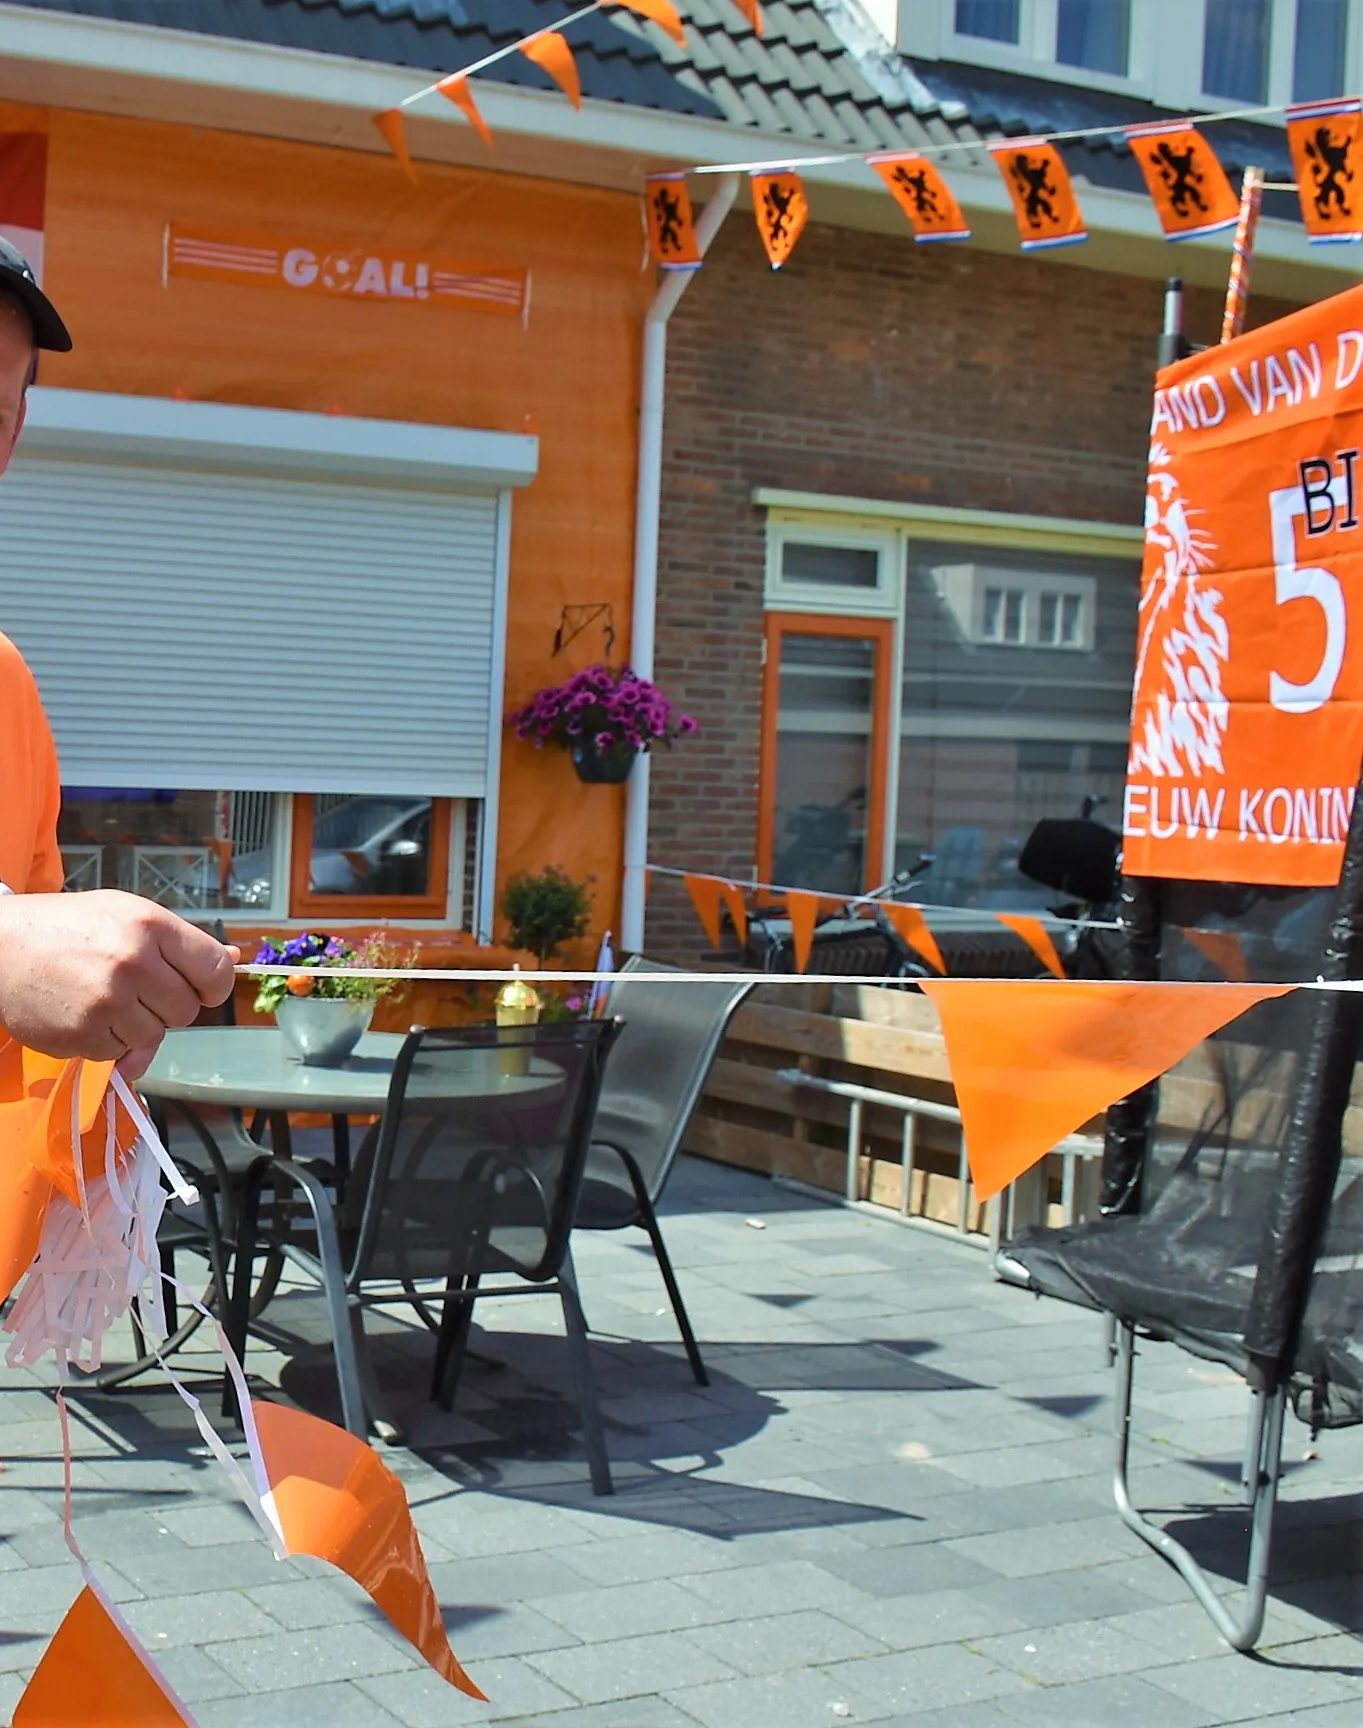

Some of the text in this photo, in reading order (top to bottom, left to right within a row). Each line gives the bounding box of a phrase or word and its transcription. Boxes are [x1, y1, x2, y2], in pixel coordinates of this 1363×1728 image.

[282, 248, 429, 299] GOAL!
[1230, 342, 1322, 417] VAN
[1269, 474, 1348, 714] 5
